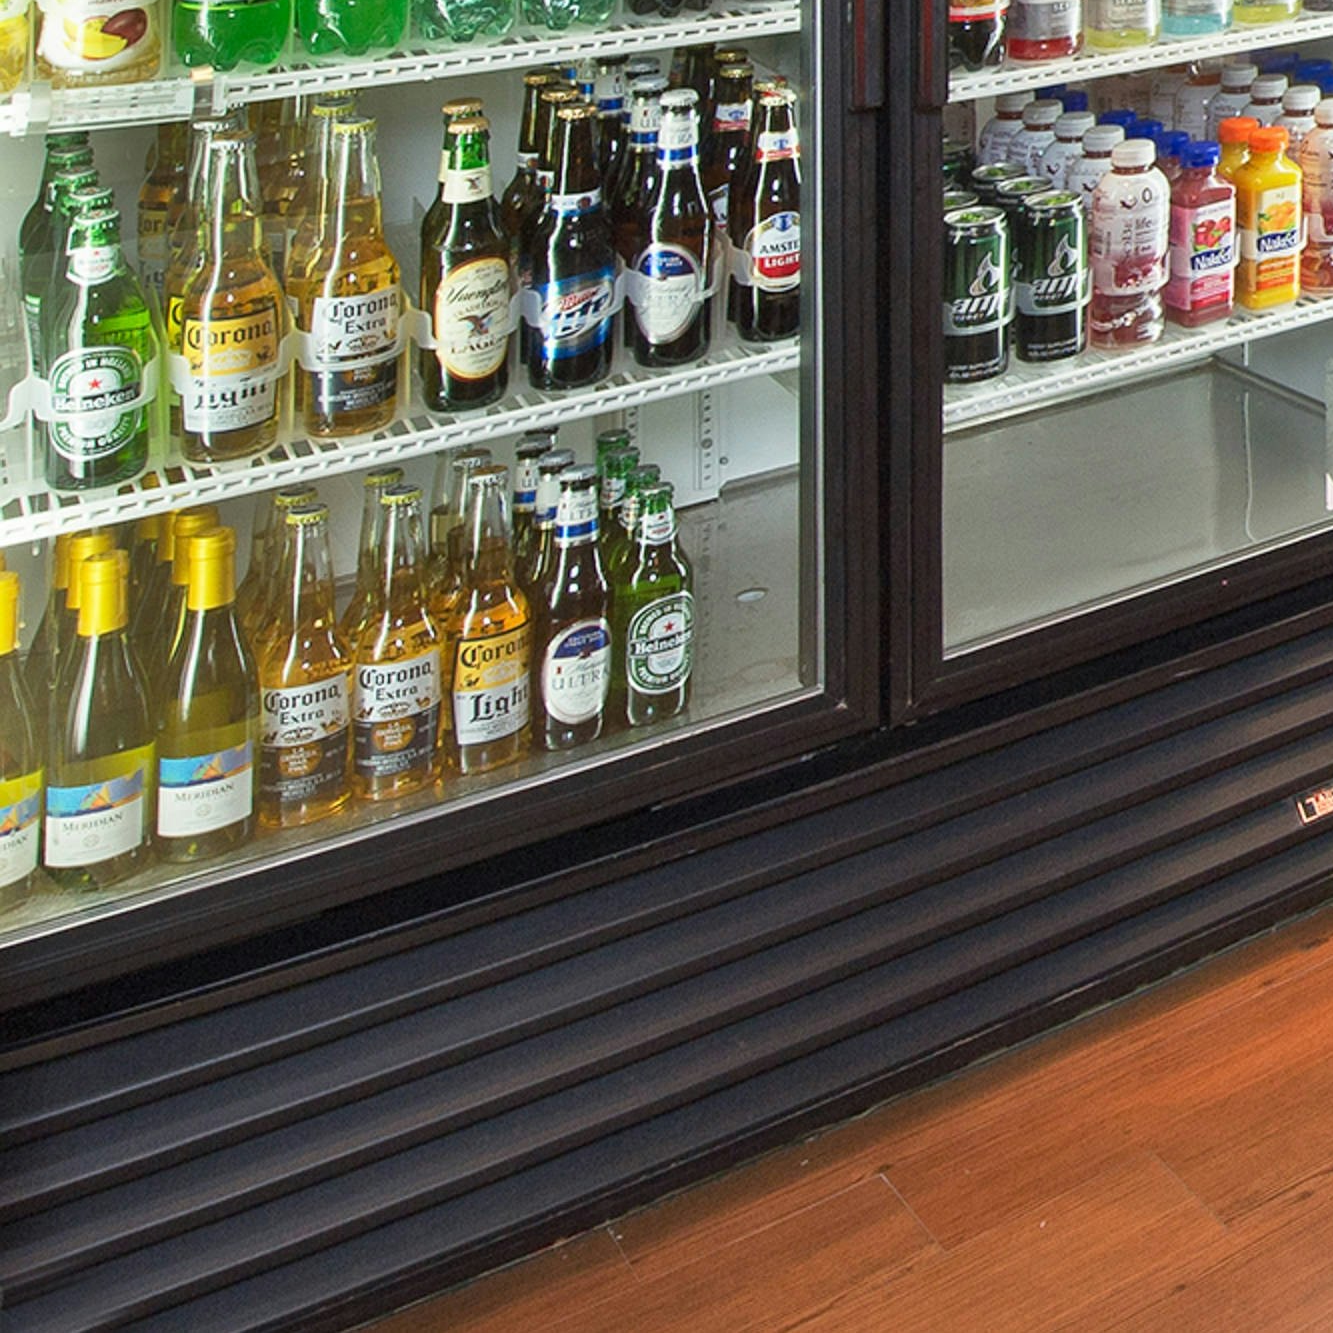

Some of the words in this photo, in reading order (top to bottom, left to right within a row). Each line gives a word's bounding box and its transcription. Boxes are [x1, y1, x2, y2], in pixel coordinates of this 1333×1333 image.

[759, 241, 800, 254] AMSTE
[765, 253, 800, 267] LIGHT
[188, 319, 273, 350] Corona
[344, 317, 386, 334] Extra
[55, 390, 135, 410] Heineken
[359, 660, 432, 690] Corona
[264, 684, 340, 715] Corona
[375, 685, 418, 701] Extra
[468, 682, 529, 723] Light
[280, 709, 324, 725] Extra
